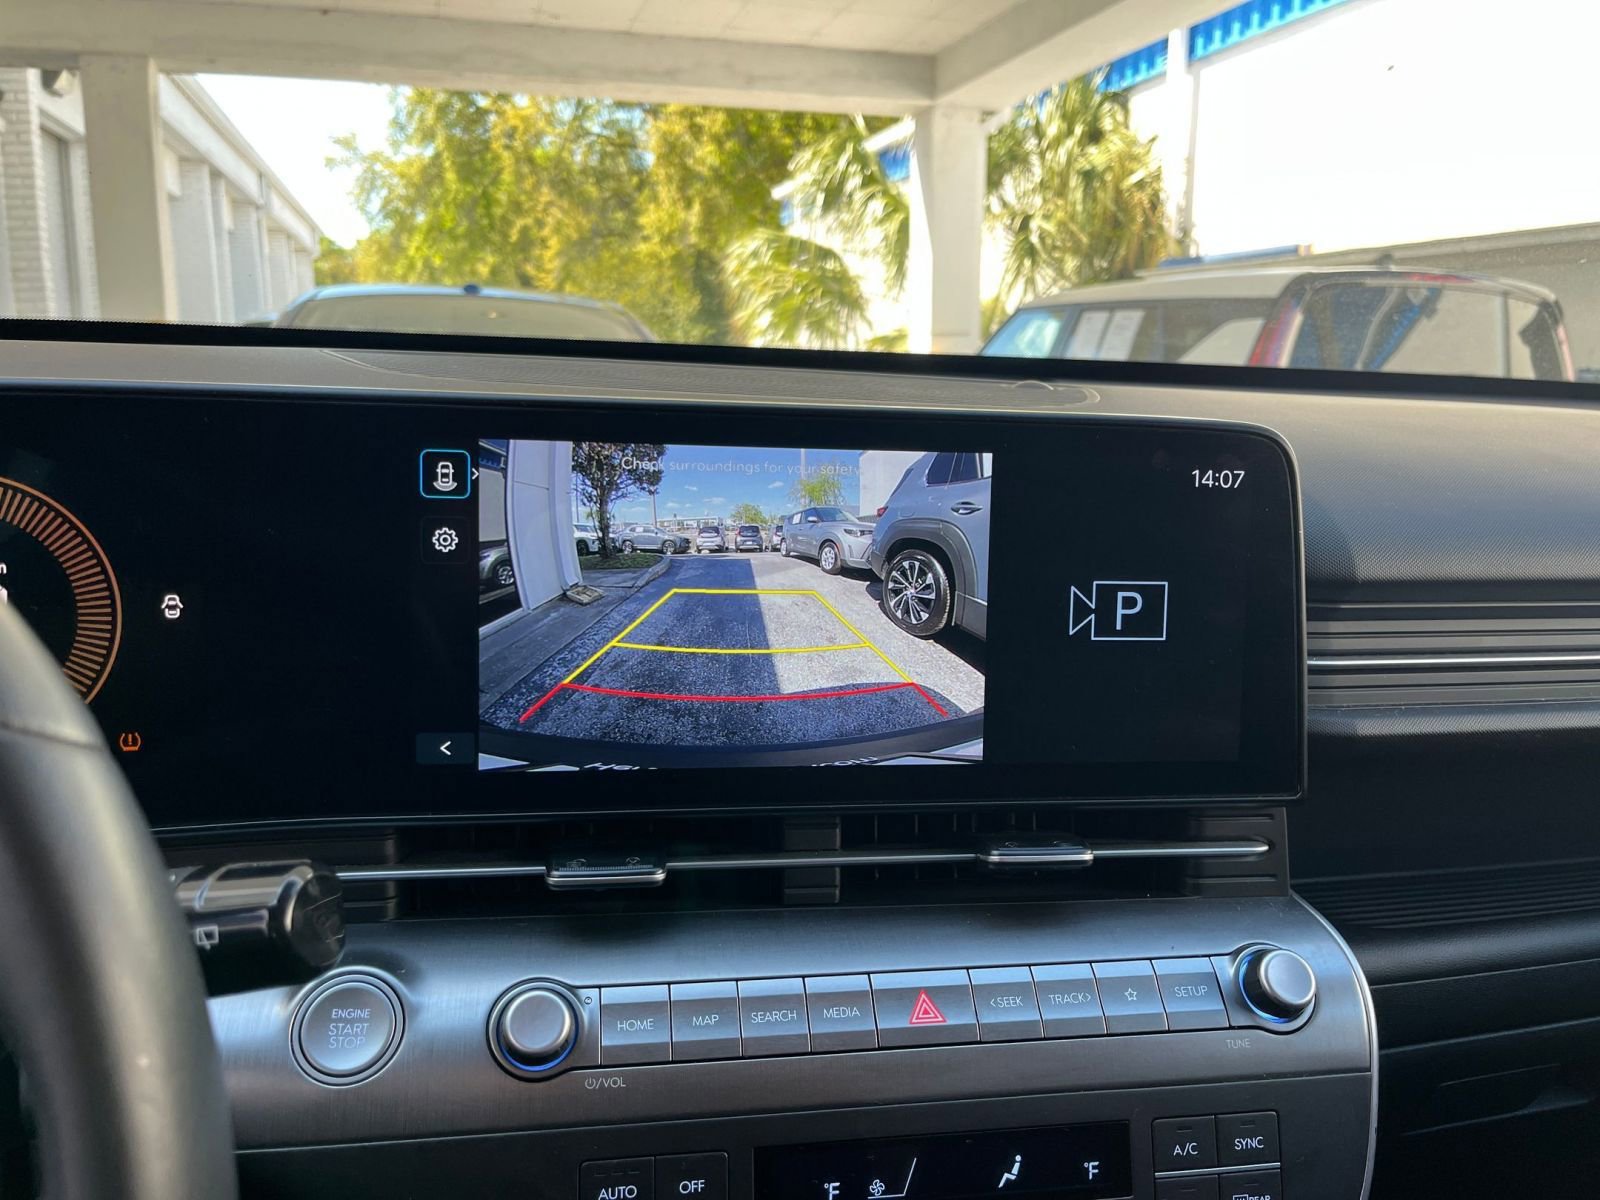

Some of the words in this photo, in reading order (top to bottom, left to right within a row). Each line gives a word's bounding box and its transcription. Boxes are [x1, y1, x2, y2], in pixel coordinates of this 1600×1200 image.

[621, 456, 665, 471] Check
[669, 457, 760, 475] surroundings
[764, 460, 782, 473] for
[787, 462, 816, 476] your
[1191, 469, 1246, 488] 14:07
[1115, 591, 1143, 630] P
[1174, 985, 1208, 998] SETUP
[331, 1008, 371, 1019] ENGINE
[751, 1010, 797, 1024] SEARCH
[823, 1006, 860, 1019] MEDIA
[617, 1018, 654, 1032] HOME
[692, 1014, 719, 1026] MAP
[328, 1022, 370, 1035] START
[328, 1036, 366, 1049] STOP
[1225, 1038, 1251, 1049] TUNE
[1173, 1142, 1199, 1156] A/C
[1234, 1136, 1264, 1150] SYNC
[598, 1185, 637, 1200] AUTO
[679, 1179, 705, 1194] OFF
